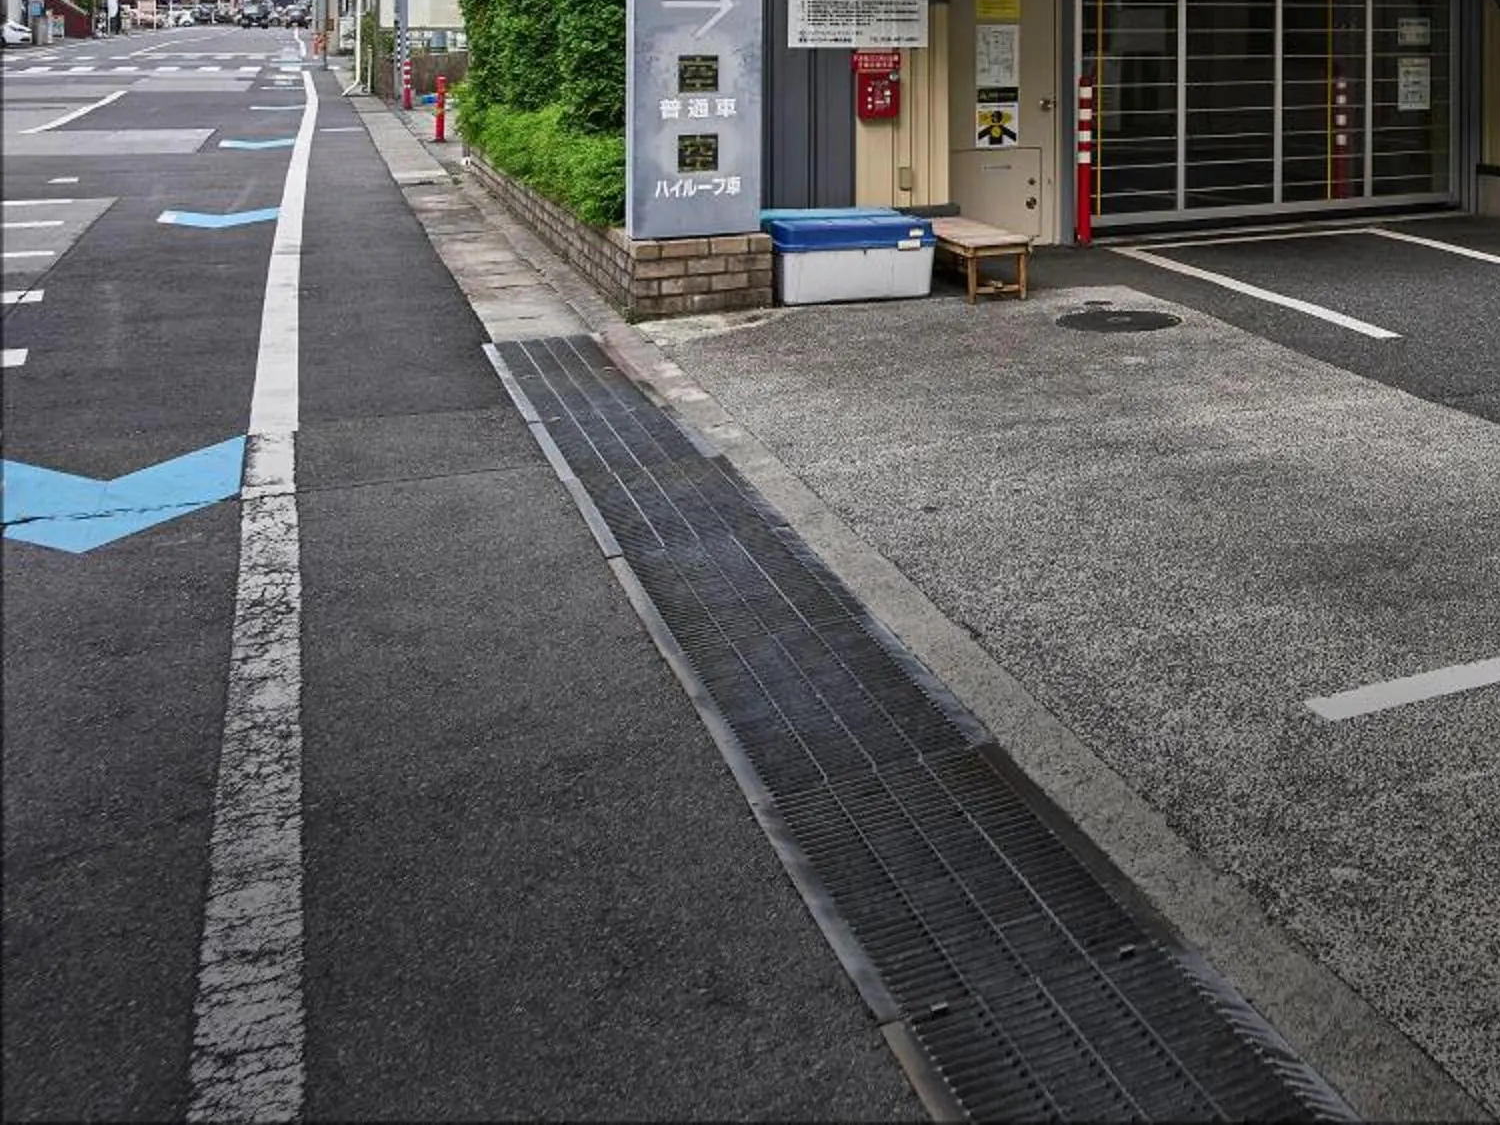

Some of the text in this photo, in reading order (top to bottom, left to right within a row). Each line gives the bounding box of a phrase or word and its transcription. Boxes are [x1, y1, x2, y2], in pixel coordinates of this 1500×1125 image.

[659, 98, 737, 119] 普通車
[655, 177, 741, 198] ハイルーフ車
